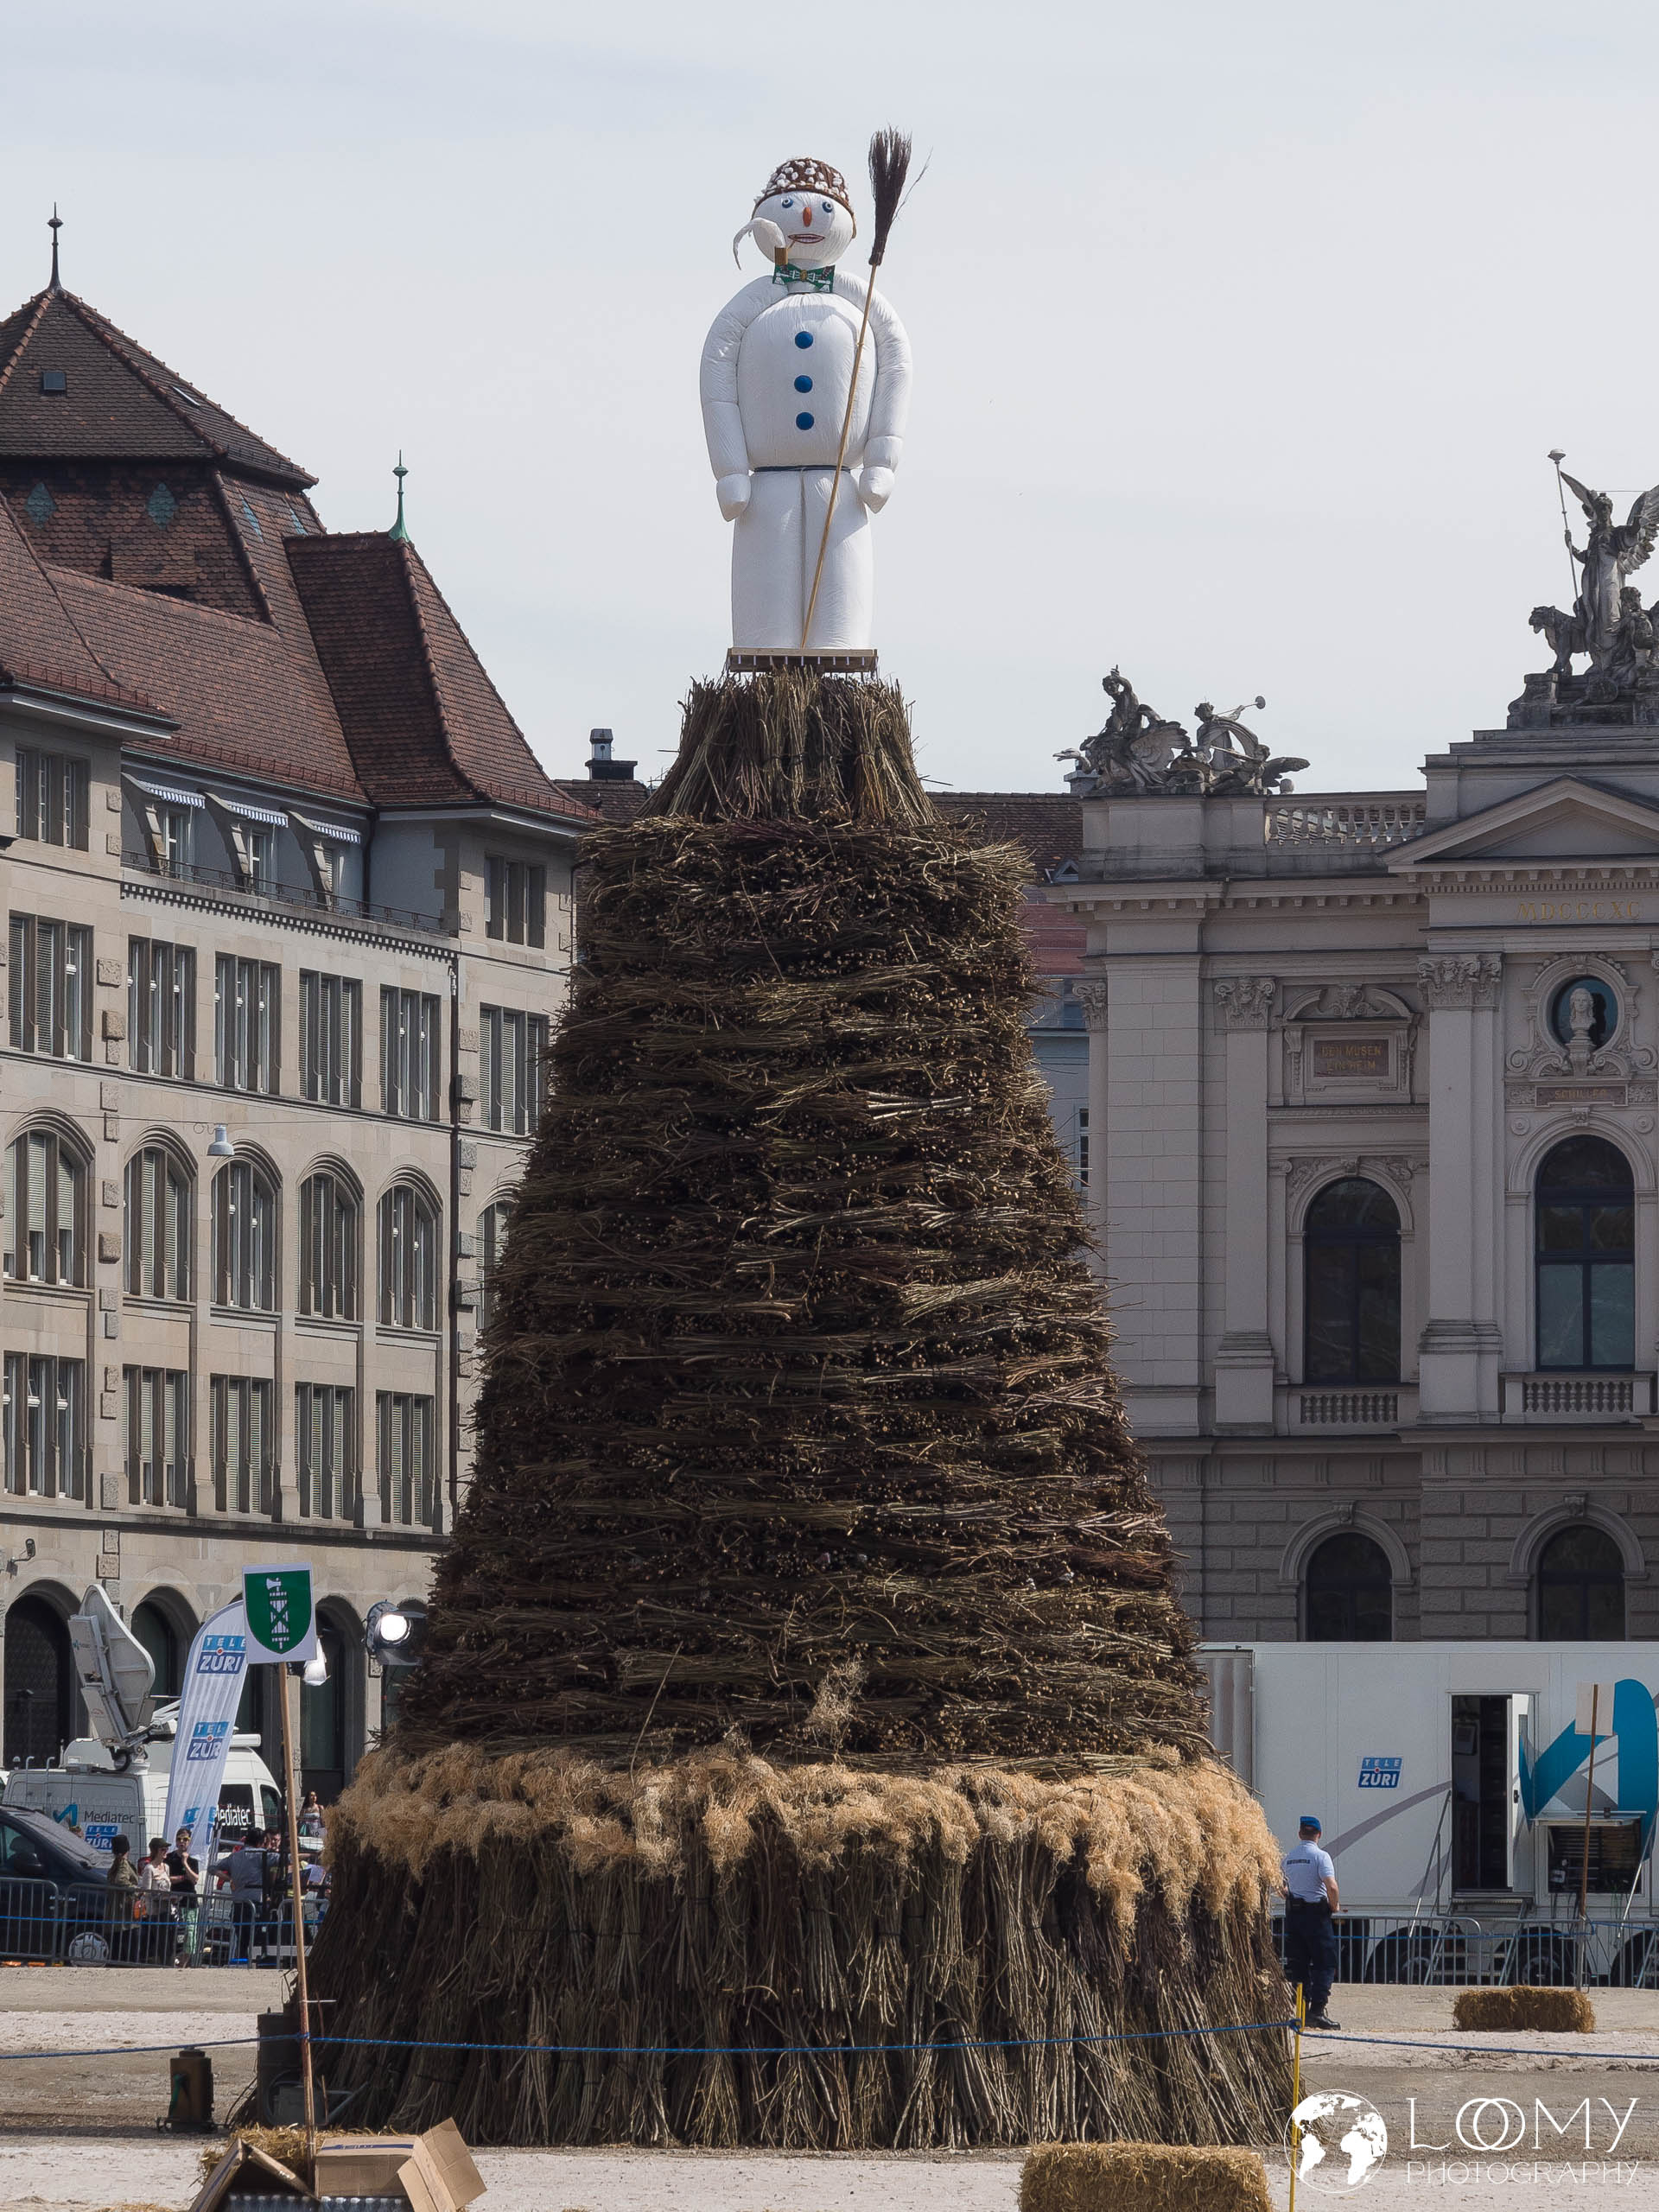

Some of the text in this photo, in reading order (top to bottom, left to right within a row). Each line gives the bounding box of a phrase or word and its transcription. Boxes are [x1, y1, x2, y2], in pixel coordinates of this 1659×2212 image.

[1515, 901, 1641, 920] MDCCCXC
[207, 1637, 246, 1647] TELE
[84, 1811, 133, 1824] Mediatec
